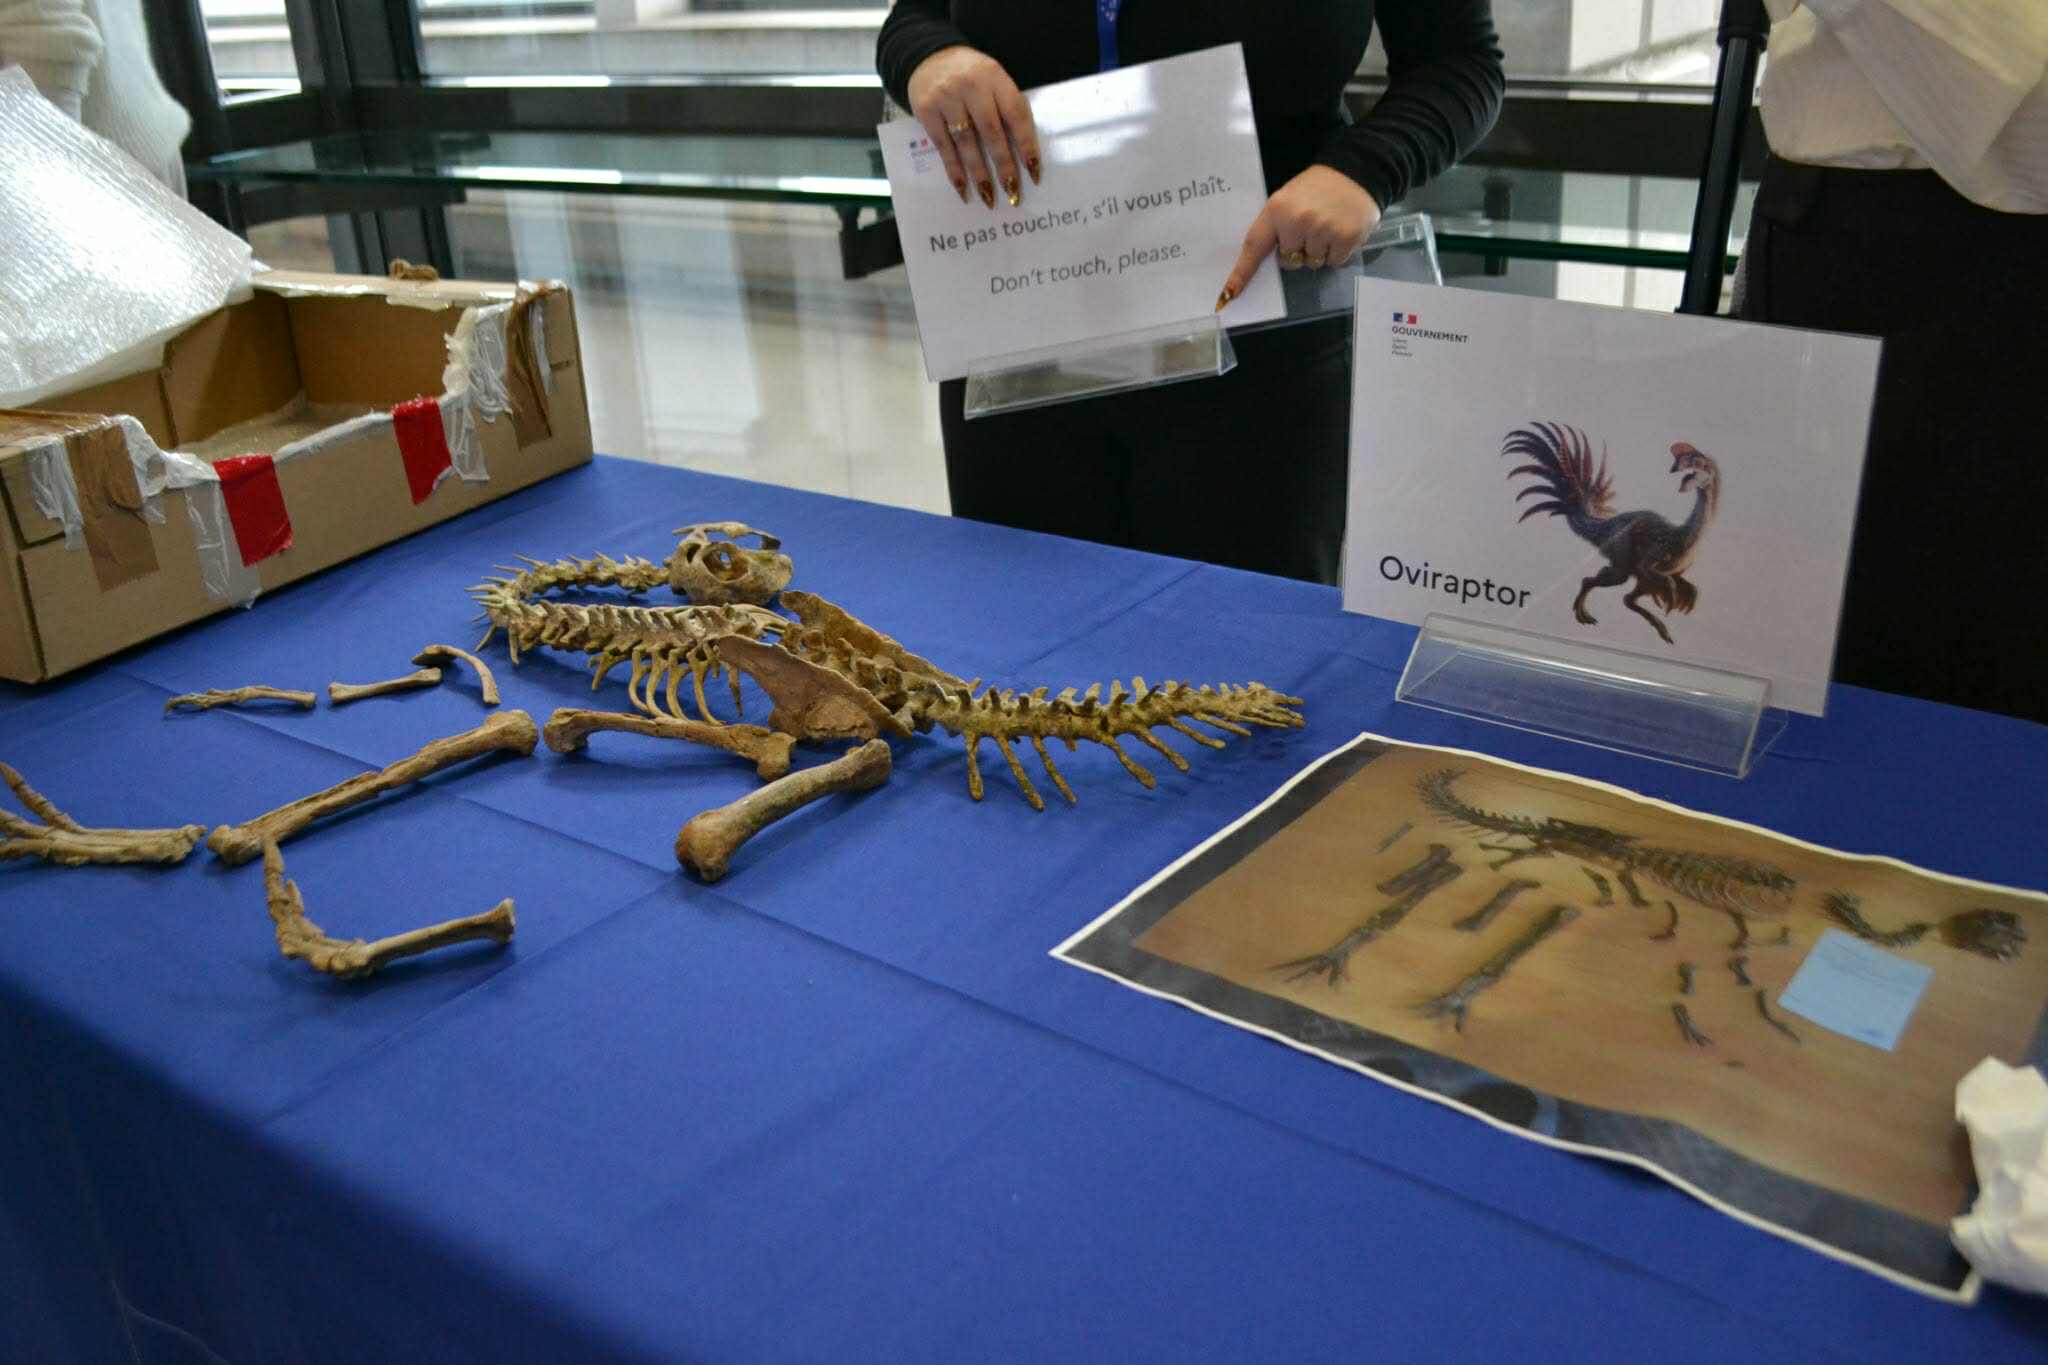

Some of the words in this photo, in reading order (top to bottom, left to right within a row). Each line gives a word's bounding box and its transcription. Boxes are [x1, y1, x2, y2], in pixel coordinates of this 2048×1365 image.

[930, 233, 958, 252] Ne
[964, 226, 998, 250] pas
[1002, 208, 1088, 237] toucher,
[1124, 189, 1173, 211] vous
[1178, 175, 1232, 206] plaît.
[1050, 255, 1112, 283] touch,
[1118, 243, 1187, 274] please.
[1391, 326, 1468, 343] GOUVERNEMENT
[1380, 555, 1532, 608] Oviraptor
